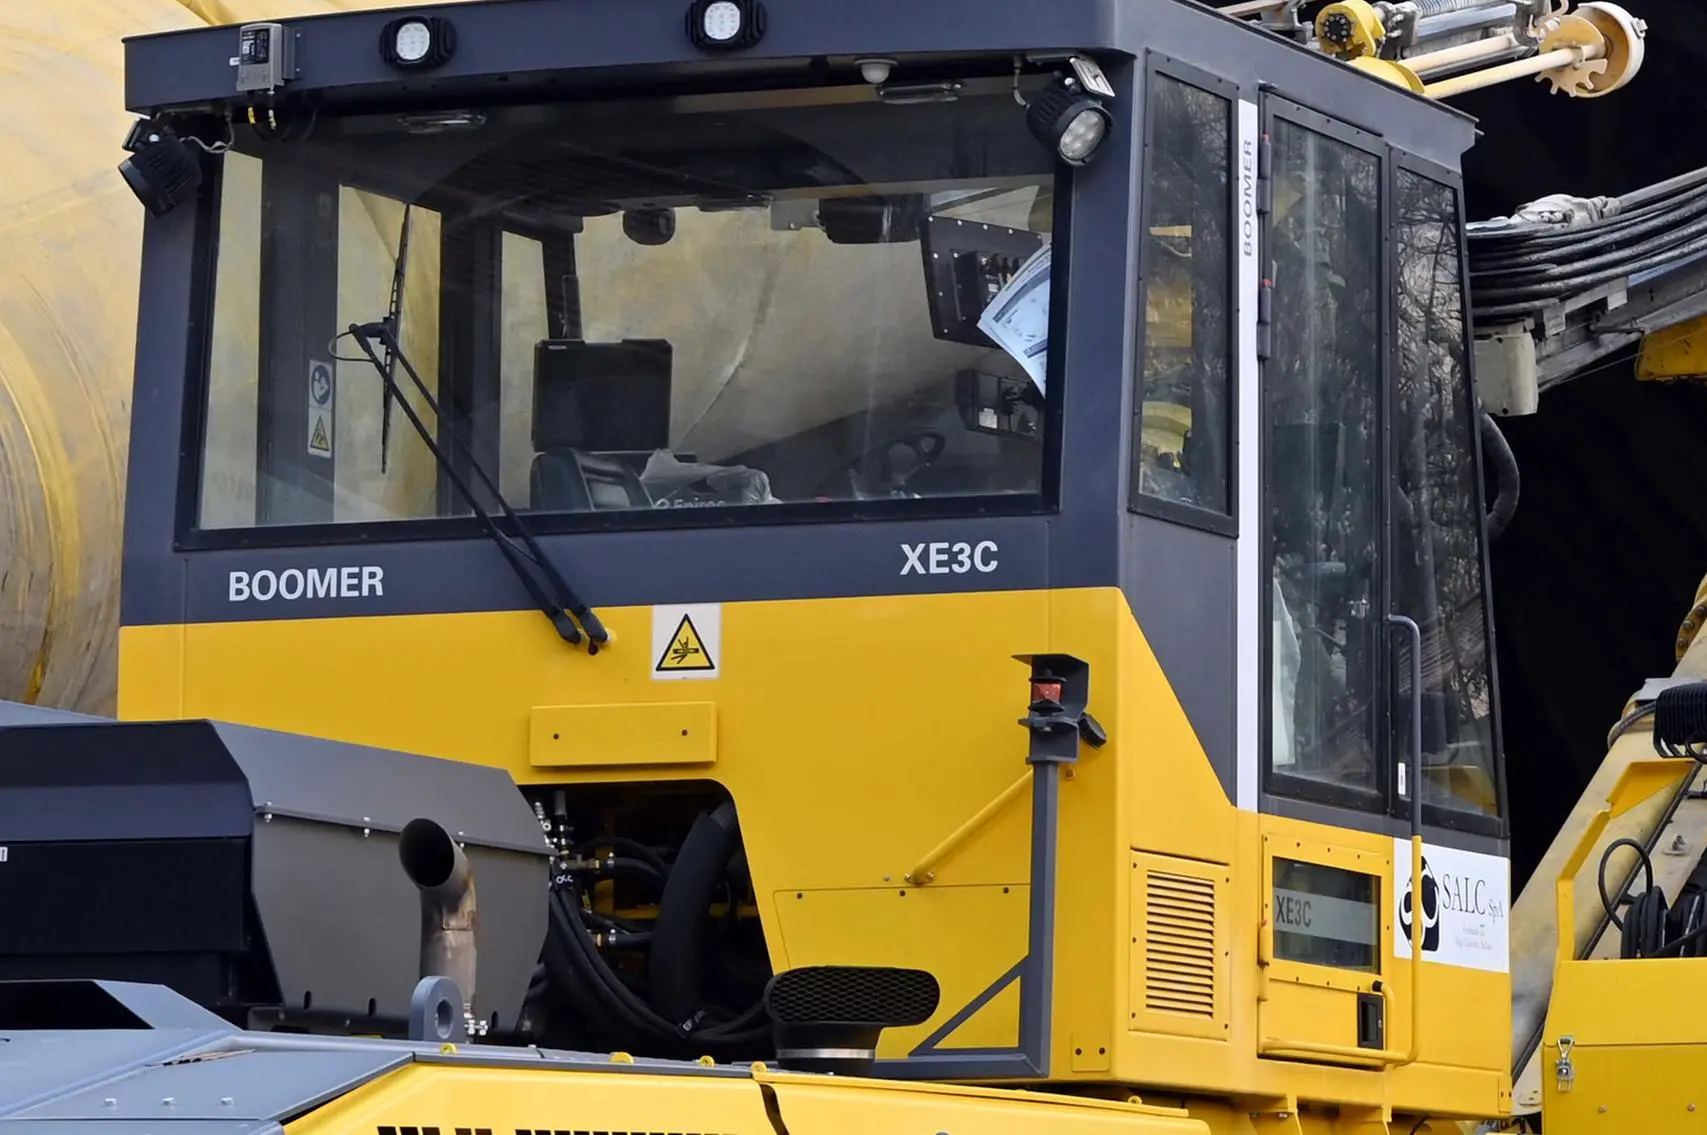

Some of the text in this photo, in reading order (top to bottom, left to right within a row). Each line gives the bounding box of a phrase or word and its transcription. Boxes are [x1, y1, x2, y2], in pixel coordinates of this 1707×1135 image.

[1243, 139, 1252, 257] BOOMER
[900, 540, 999, 576] XE3C
[229, 566, 384, 601] BOOMER
[1275, 894, 1312, 929] XE3C
[1442, 873, 1487, 916] SALC
